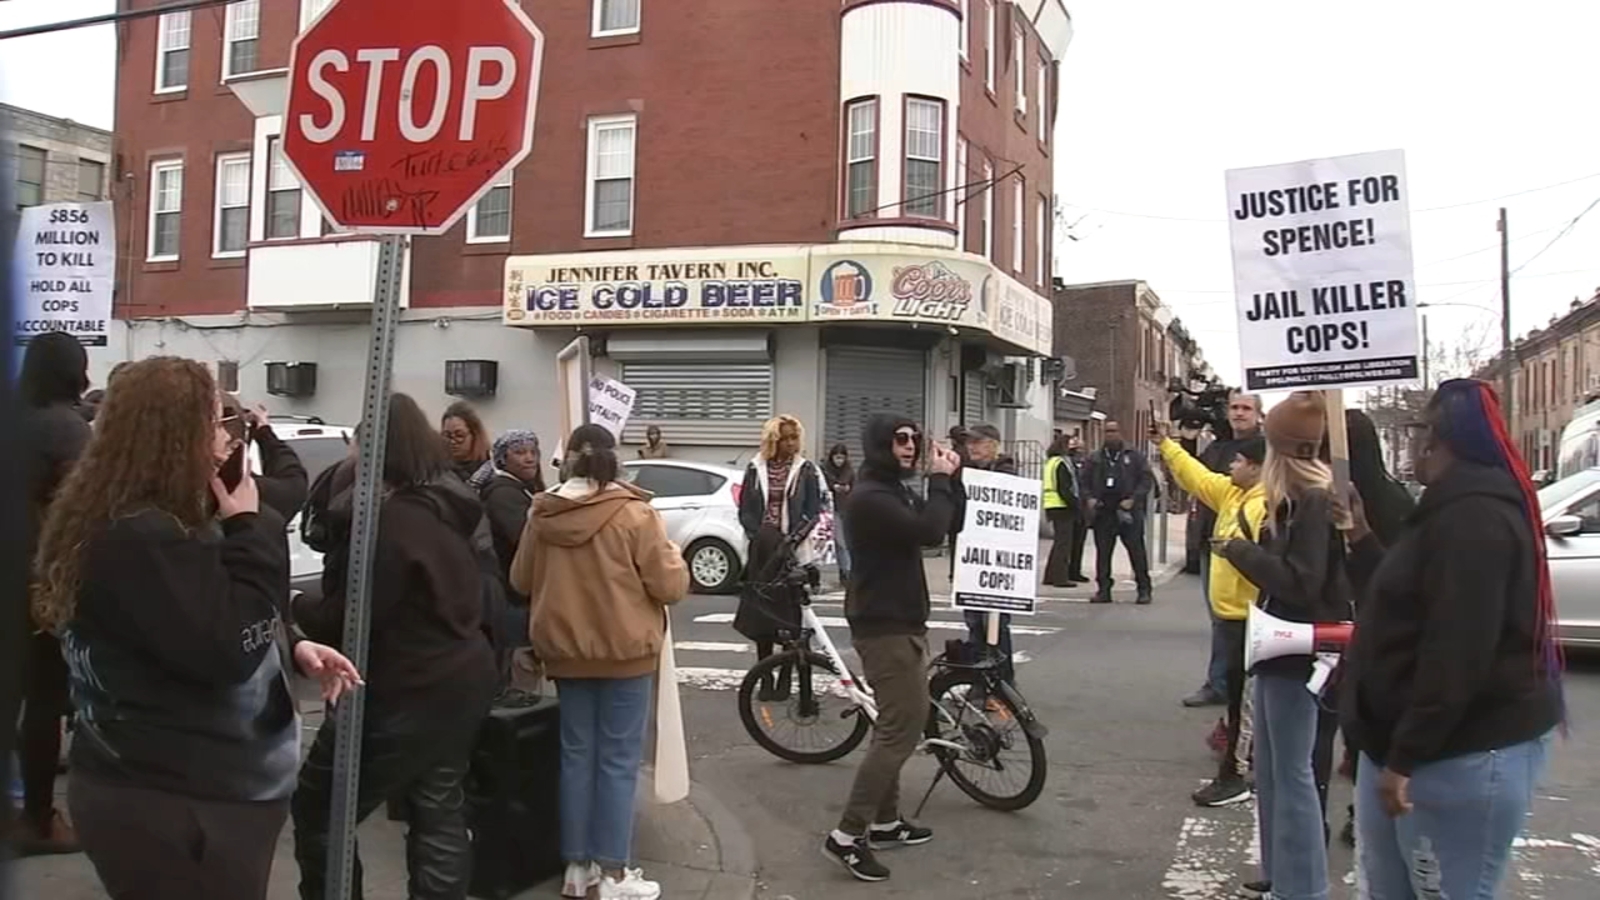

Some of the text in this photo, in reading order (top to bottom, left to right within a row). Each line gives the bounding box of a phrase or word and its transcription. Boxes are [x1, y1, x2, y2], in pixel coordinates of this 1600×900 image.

[300, 45, 516, 143] STOP
[1234, 175, 1400, 220] JUSTICE FOR
[49, 209, 89, 223] $856
[35, 231, 99, 245] MILLION
[1263, 218, 1375, 256] SPENCE!
[37, 252, 94, 266] TO KILL
[546, 261, 778, 283] JENNIFER TAVERN INC.
[30, 281, 92, 293] HOLD ALL
[892, 264, 972, 302] Coors
[526, 285, 580, 311] ICE
[592, 282, 688, 309] COLD
[701, 279, 802, 307] BEER
[1246, 280, 1407, 321] JAIL KILLER
[42, 300, 79, 312] COPS
[543, 308, 799, 320] FOOD CANDIES CIGARETTE SODA ATM
[892, 299, 966, 320] LIGHT
[16, 320, 105, 332] ACCOUNTABLE
[1287, 321, 1369, 354] COPS!
[1255, 369, 1281, 377] PARTY
[1282, 367, 1299, 375] FOR
[1364, 360, 1411, 368] LIBERATION
[604, 385, 632, 406] POLICE
[967, 484, 1038, 510] JUSTICE FOR
[976, 510, 1025, 531] SPENCE!
[962, 547, 1033, 570] JAIL KILLER
[979, 570, 1015, 590] COPS!
